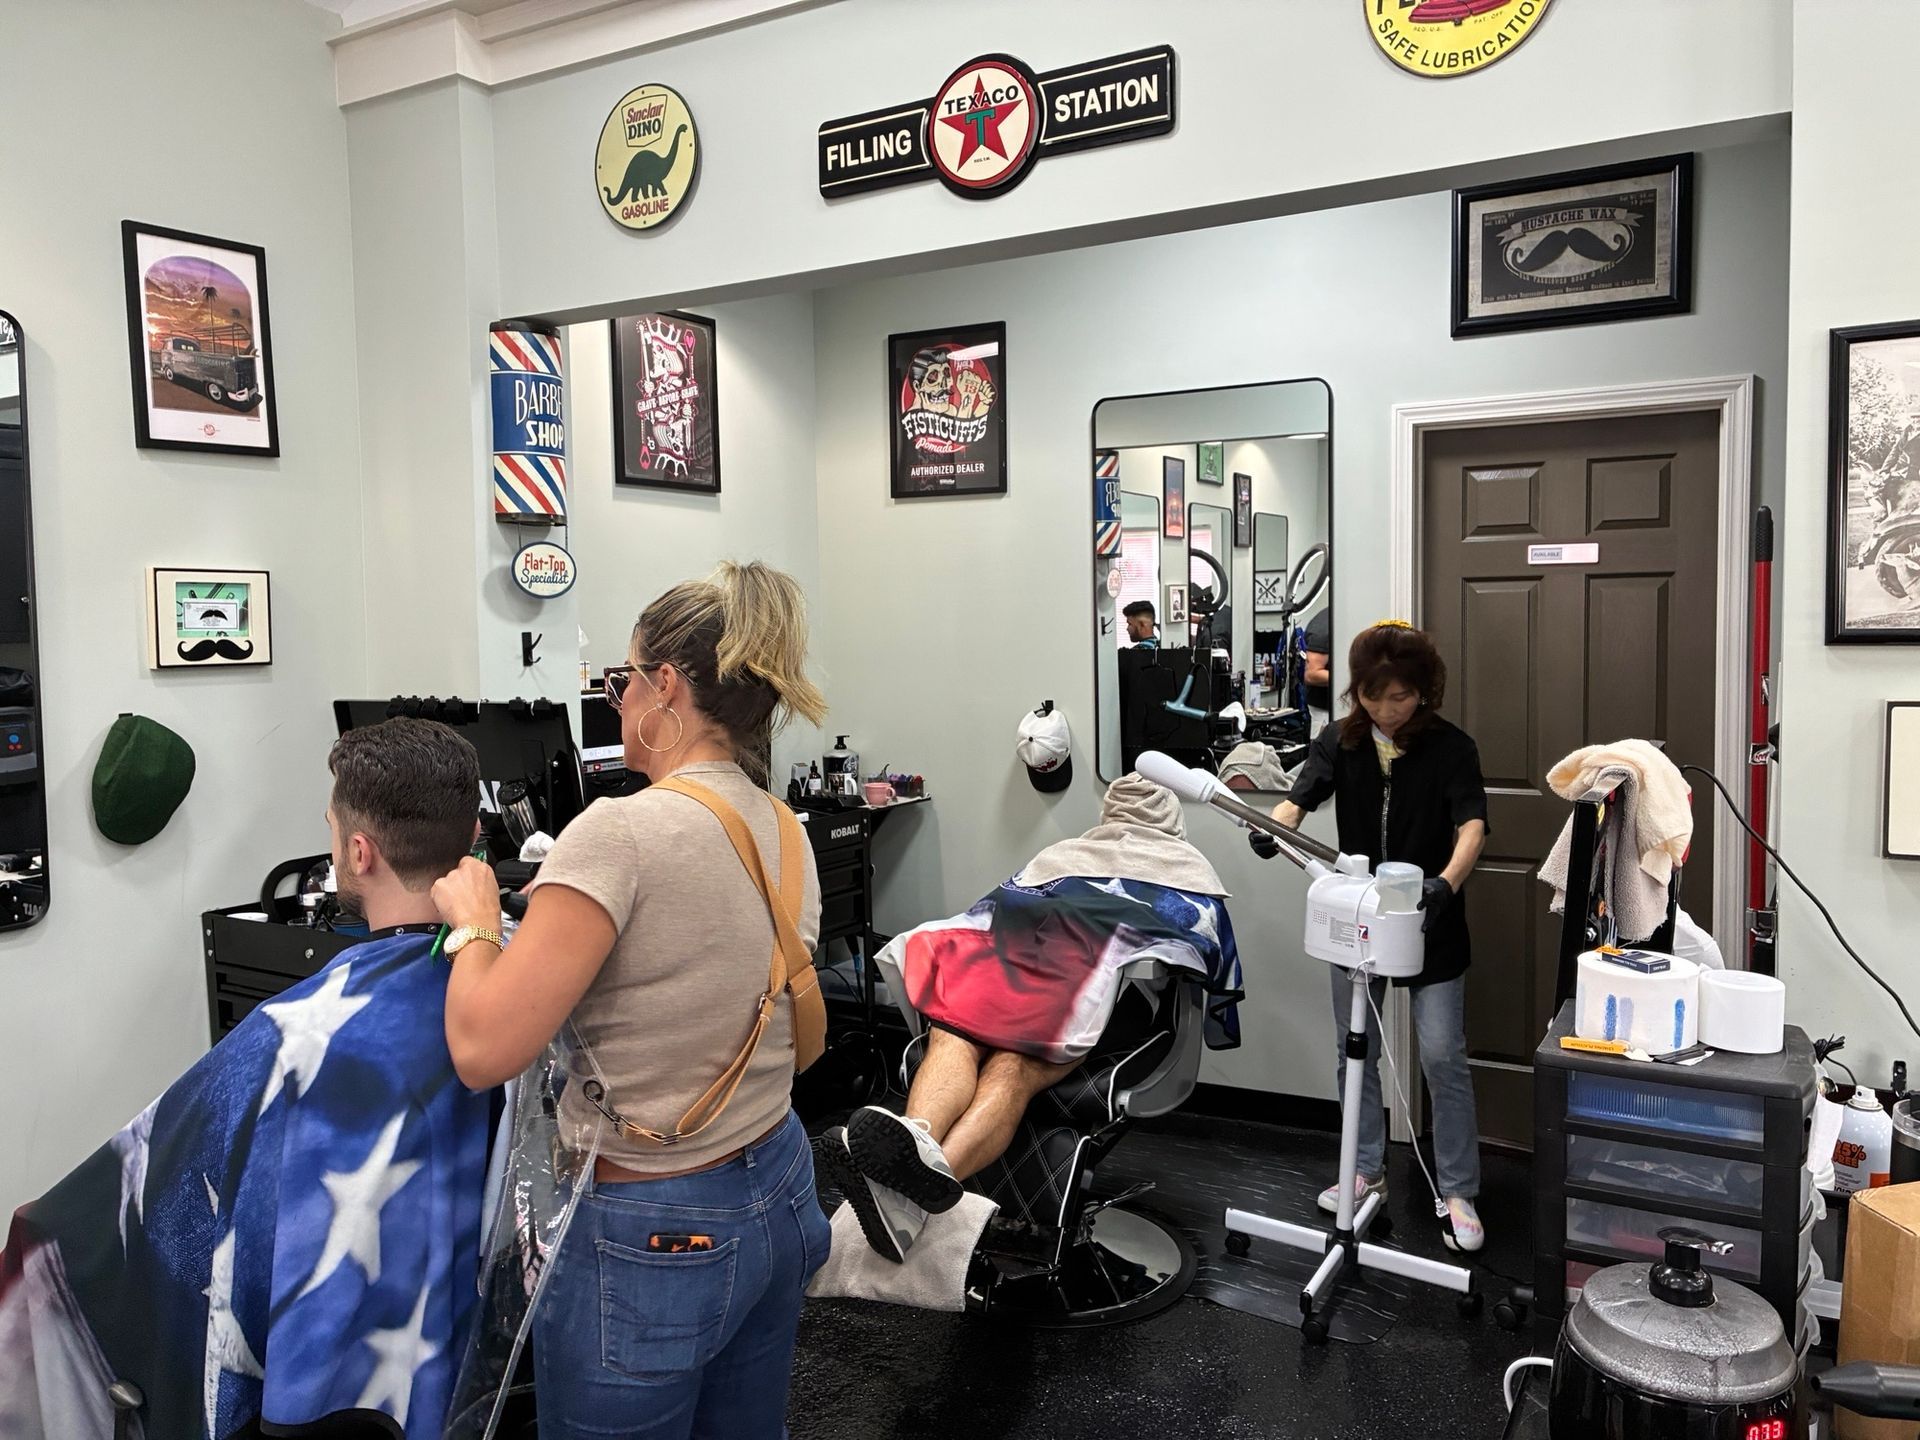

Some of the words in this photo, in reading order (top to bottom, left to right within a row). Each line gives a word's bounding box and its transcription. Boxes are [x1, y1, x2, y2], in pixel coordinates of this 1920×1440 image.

[1378, 18, 1419, 61] SAFE
[1420, 0, 1543, 69] LUBRICATIO
[944, 85, 1019, 115] TEXACO
[1054, 74, 1159, 122] STATION
[626, 102, 664, 125] Sinclair
[628, 118, 661, 140] DINO
[965, 108, 995, 146] T
[826, 129, 912, 171] FILLING
[621, 198, 669, 220] GASOLINE
[1521, 209, 1585, 232] MUSTACHE
[1590, 208, 1617, 220] WAX
[525, 420, 564, 450] SHOP
[901, 411, 988, 444] FISTICUFFS
[915, 437, 958, 453] Pomade
[911, 463, 955, 477] AUTHORIZED
[956, 462, 985, 474] DEALER
[524, 552, 566, 575] Flat-Top
[520, 568, 570, 589] Specialist
[830, 824, 860, 840] KOBALT
